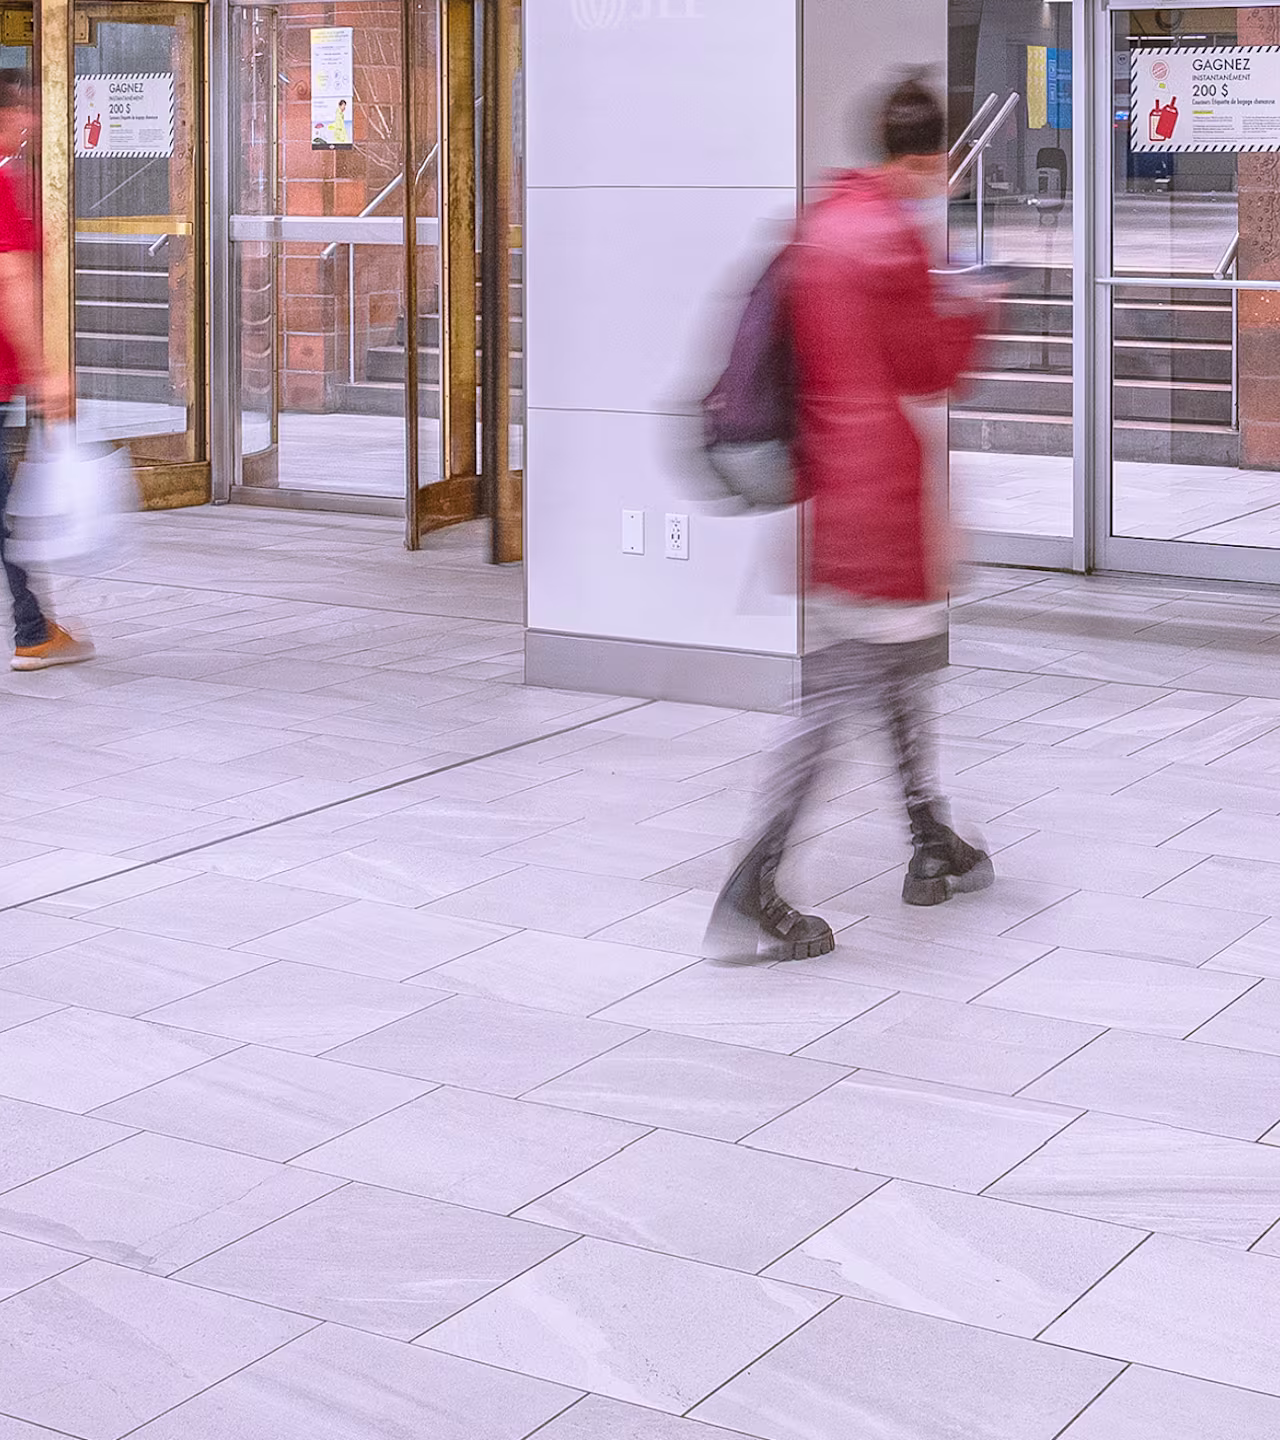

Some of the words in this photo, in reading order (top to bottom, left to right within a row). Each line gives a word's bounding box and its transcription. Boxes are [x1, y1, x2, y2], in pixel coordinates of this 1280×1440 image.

[1192, 58, 1251, 71] GAGNEZ
[1192, 73, 1251, 81] INSTANTANÉMENT
[109, 82, 144, 93] GAGNEZ
[1192, 84, 1217, 97] 200
[1221, 83, 1229, 98] $
[109, 104, 124, 114] 200
[125, 103, 131, 114] $
